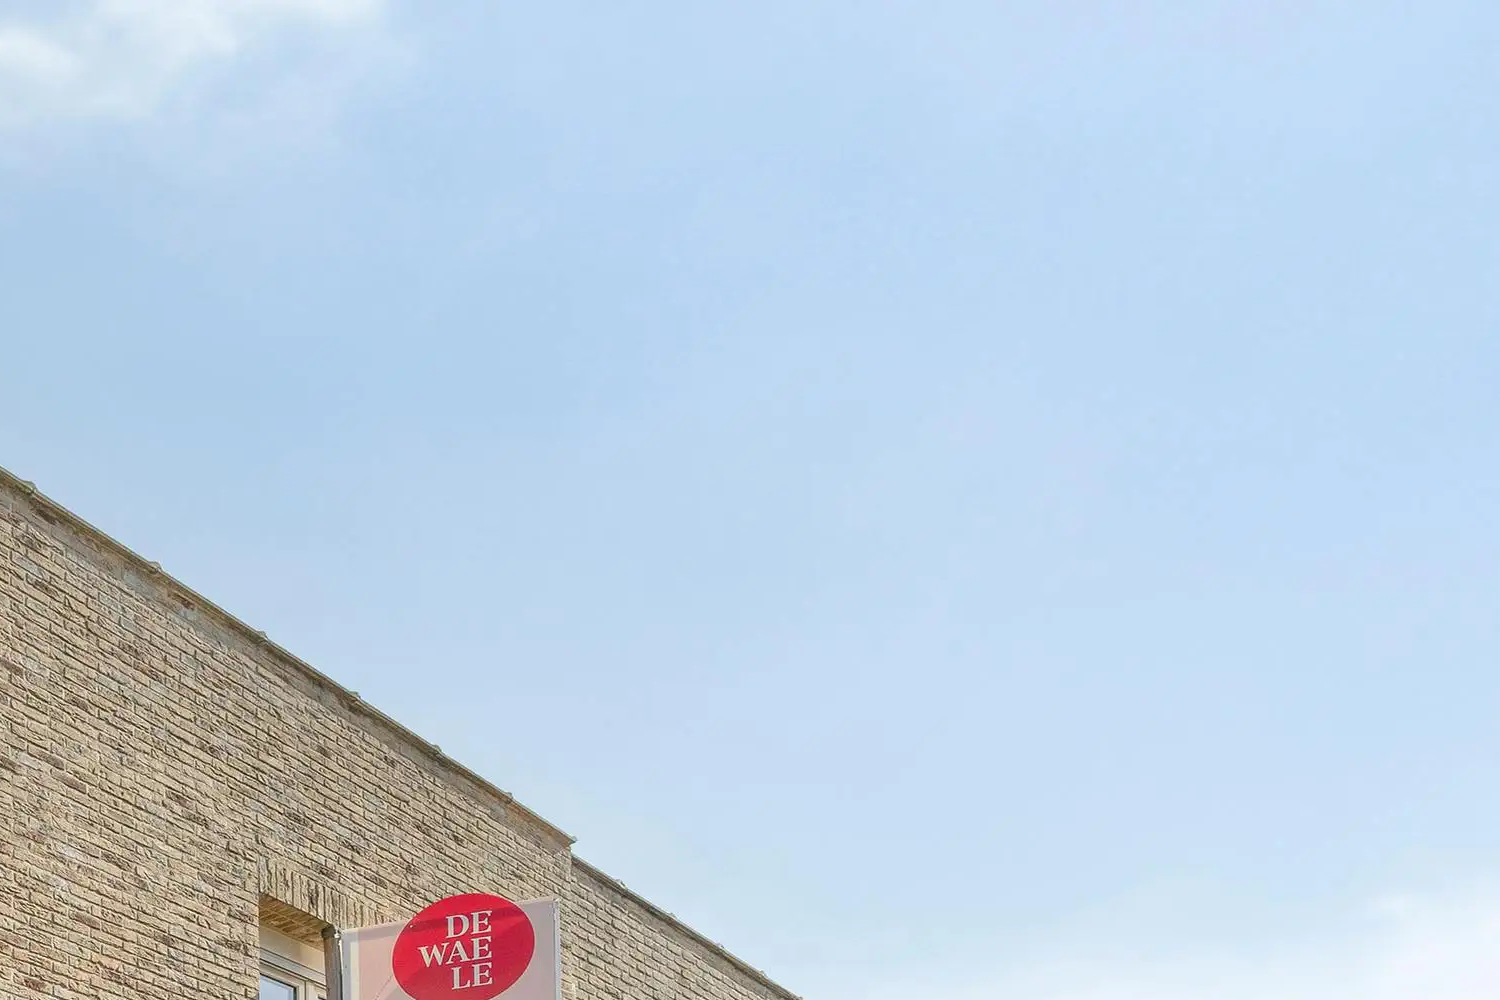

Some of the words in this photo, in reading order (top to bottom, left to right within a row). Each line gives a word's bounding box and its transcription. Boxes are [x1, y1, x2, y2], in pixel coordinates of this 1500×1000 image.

[446, 910, 493, 938] DE
[417, 936, 493, 968] WAE
[451, 962, 493, 990] LE
